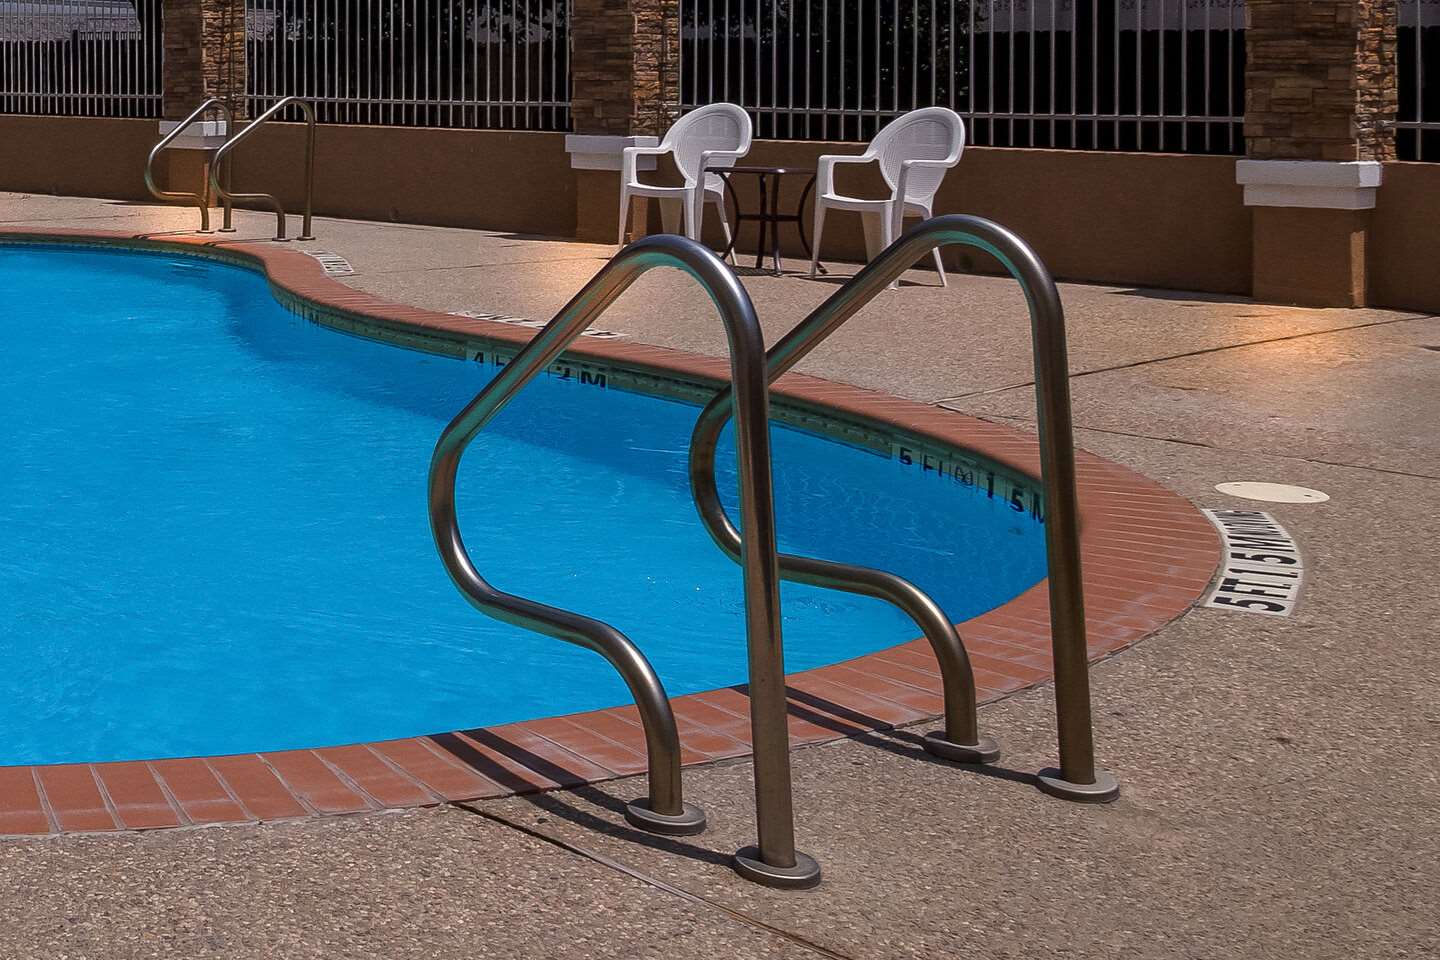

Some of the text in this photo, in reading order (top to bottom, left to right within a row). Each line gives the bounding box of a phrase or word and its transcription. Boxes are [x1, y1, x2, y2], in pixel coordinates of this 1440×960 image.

[580, 371, 607, 388] M
[899, 447, 913, 466] 5
[1213, 596, 1286, 613] 5
